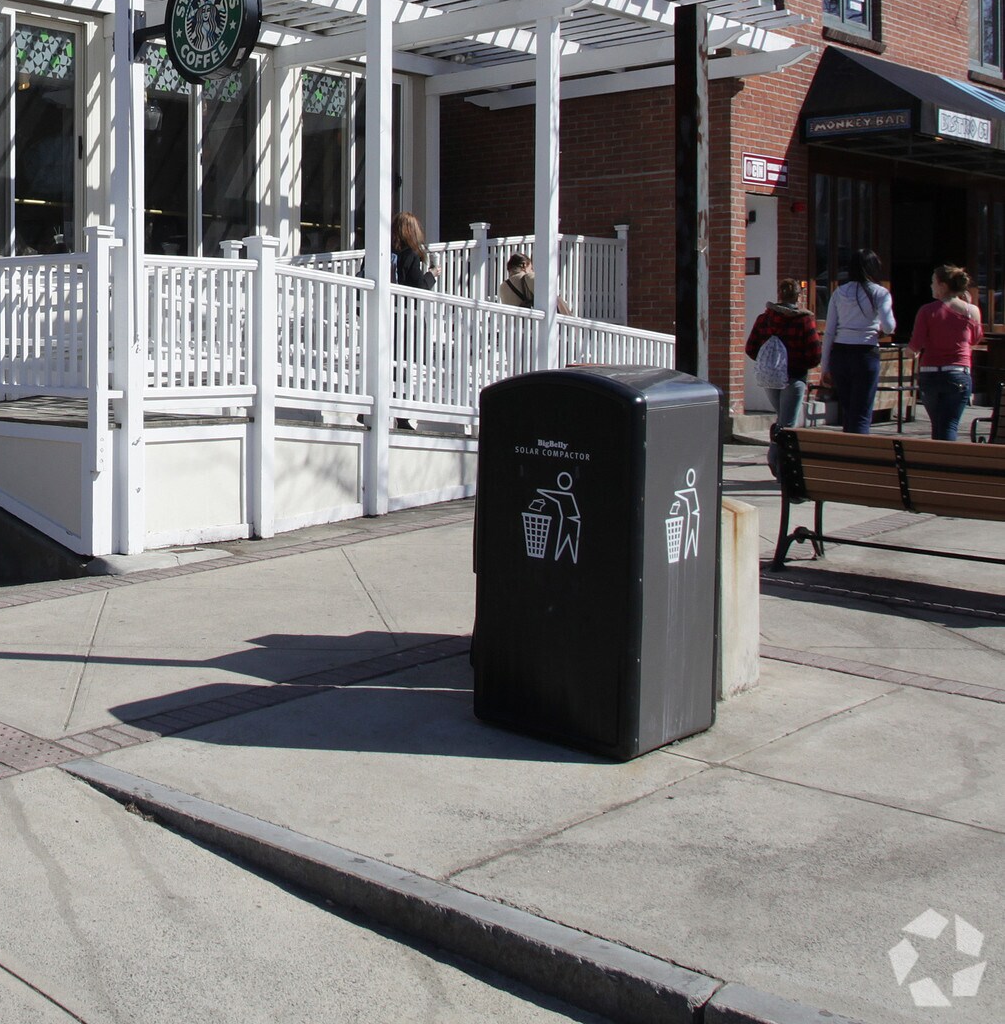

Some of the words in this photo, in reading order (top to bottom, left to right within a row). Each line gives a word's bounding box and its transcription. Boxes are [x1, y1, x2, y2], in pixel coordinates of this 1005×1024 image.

[181, 40, 228, 69] COFFEE
[815, 118, 871, 132] MONKEY
[876, 115, 905, 127] BAR
[941, 112, 977, 138] BISTRO
[537, 439, 568, 450] BigBelly
[514, 446, 539, 455] SOLAR
[542, 449, 591, 461] COMPACTOR
